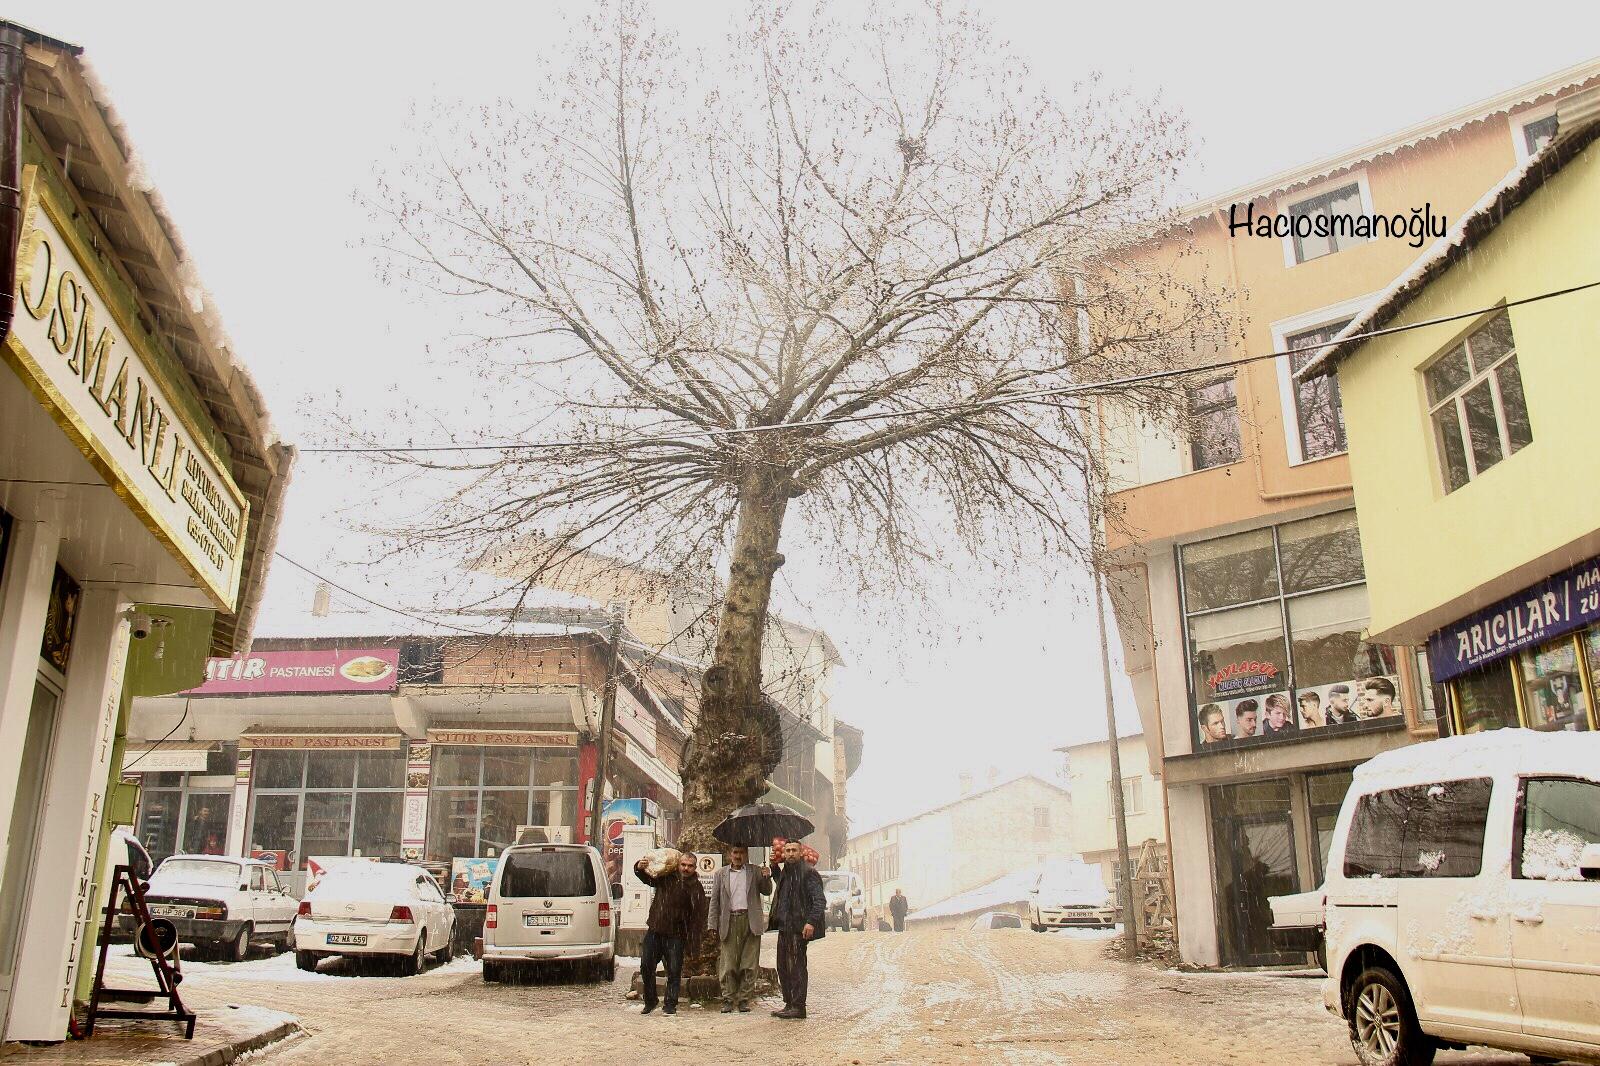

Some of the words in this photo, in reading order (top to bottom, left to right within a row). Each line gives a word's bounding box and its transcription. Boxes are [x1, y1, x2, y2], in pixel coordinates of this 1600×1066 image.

[20, 229, 184, 503] OSMANLI
[269, 664, 336, 678] PASTANESİ
[1457, 591, 1560, 661] ARICILAR
[61, 792, 100, 1008] KUYUMCULUK
